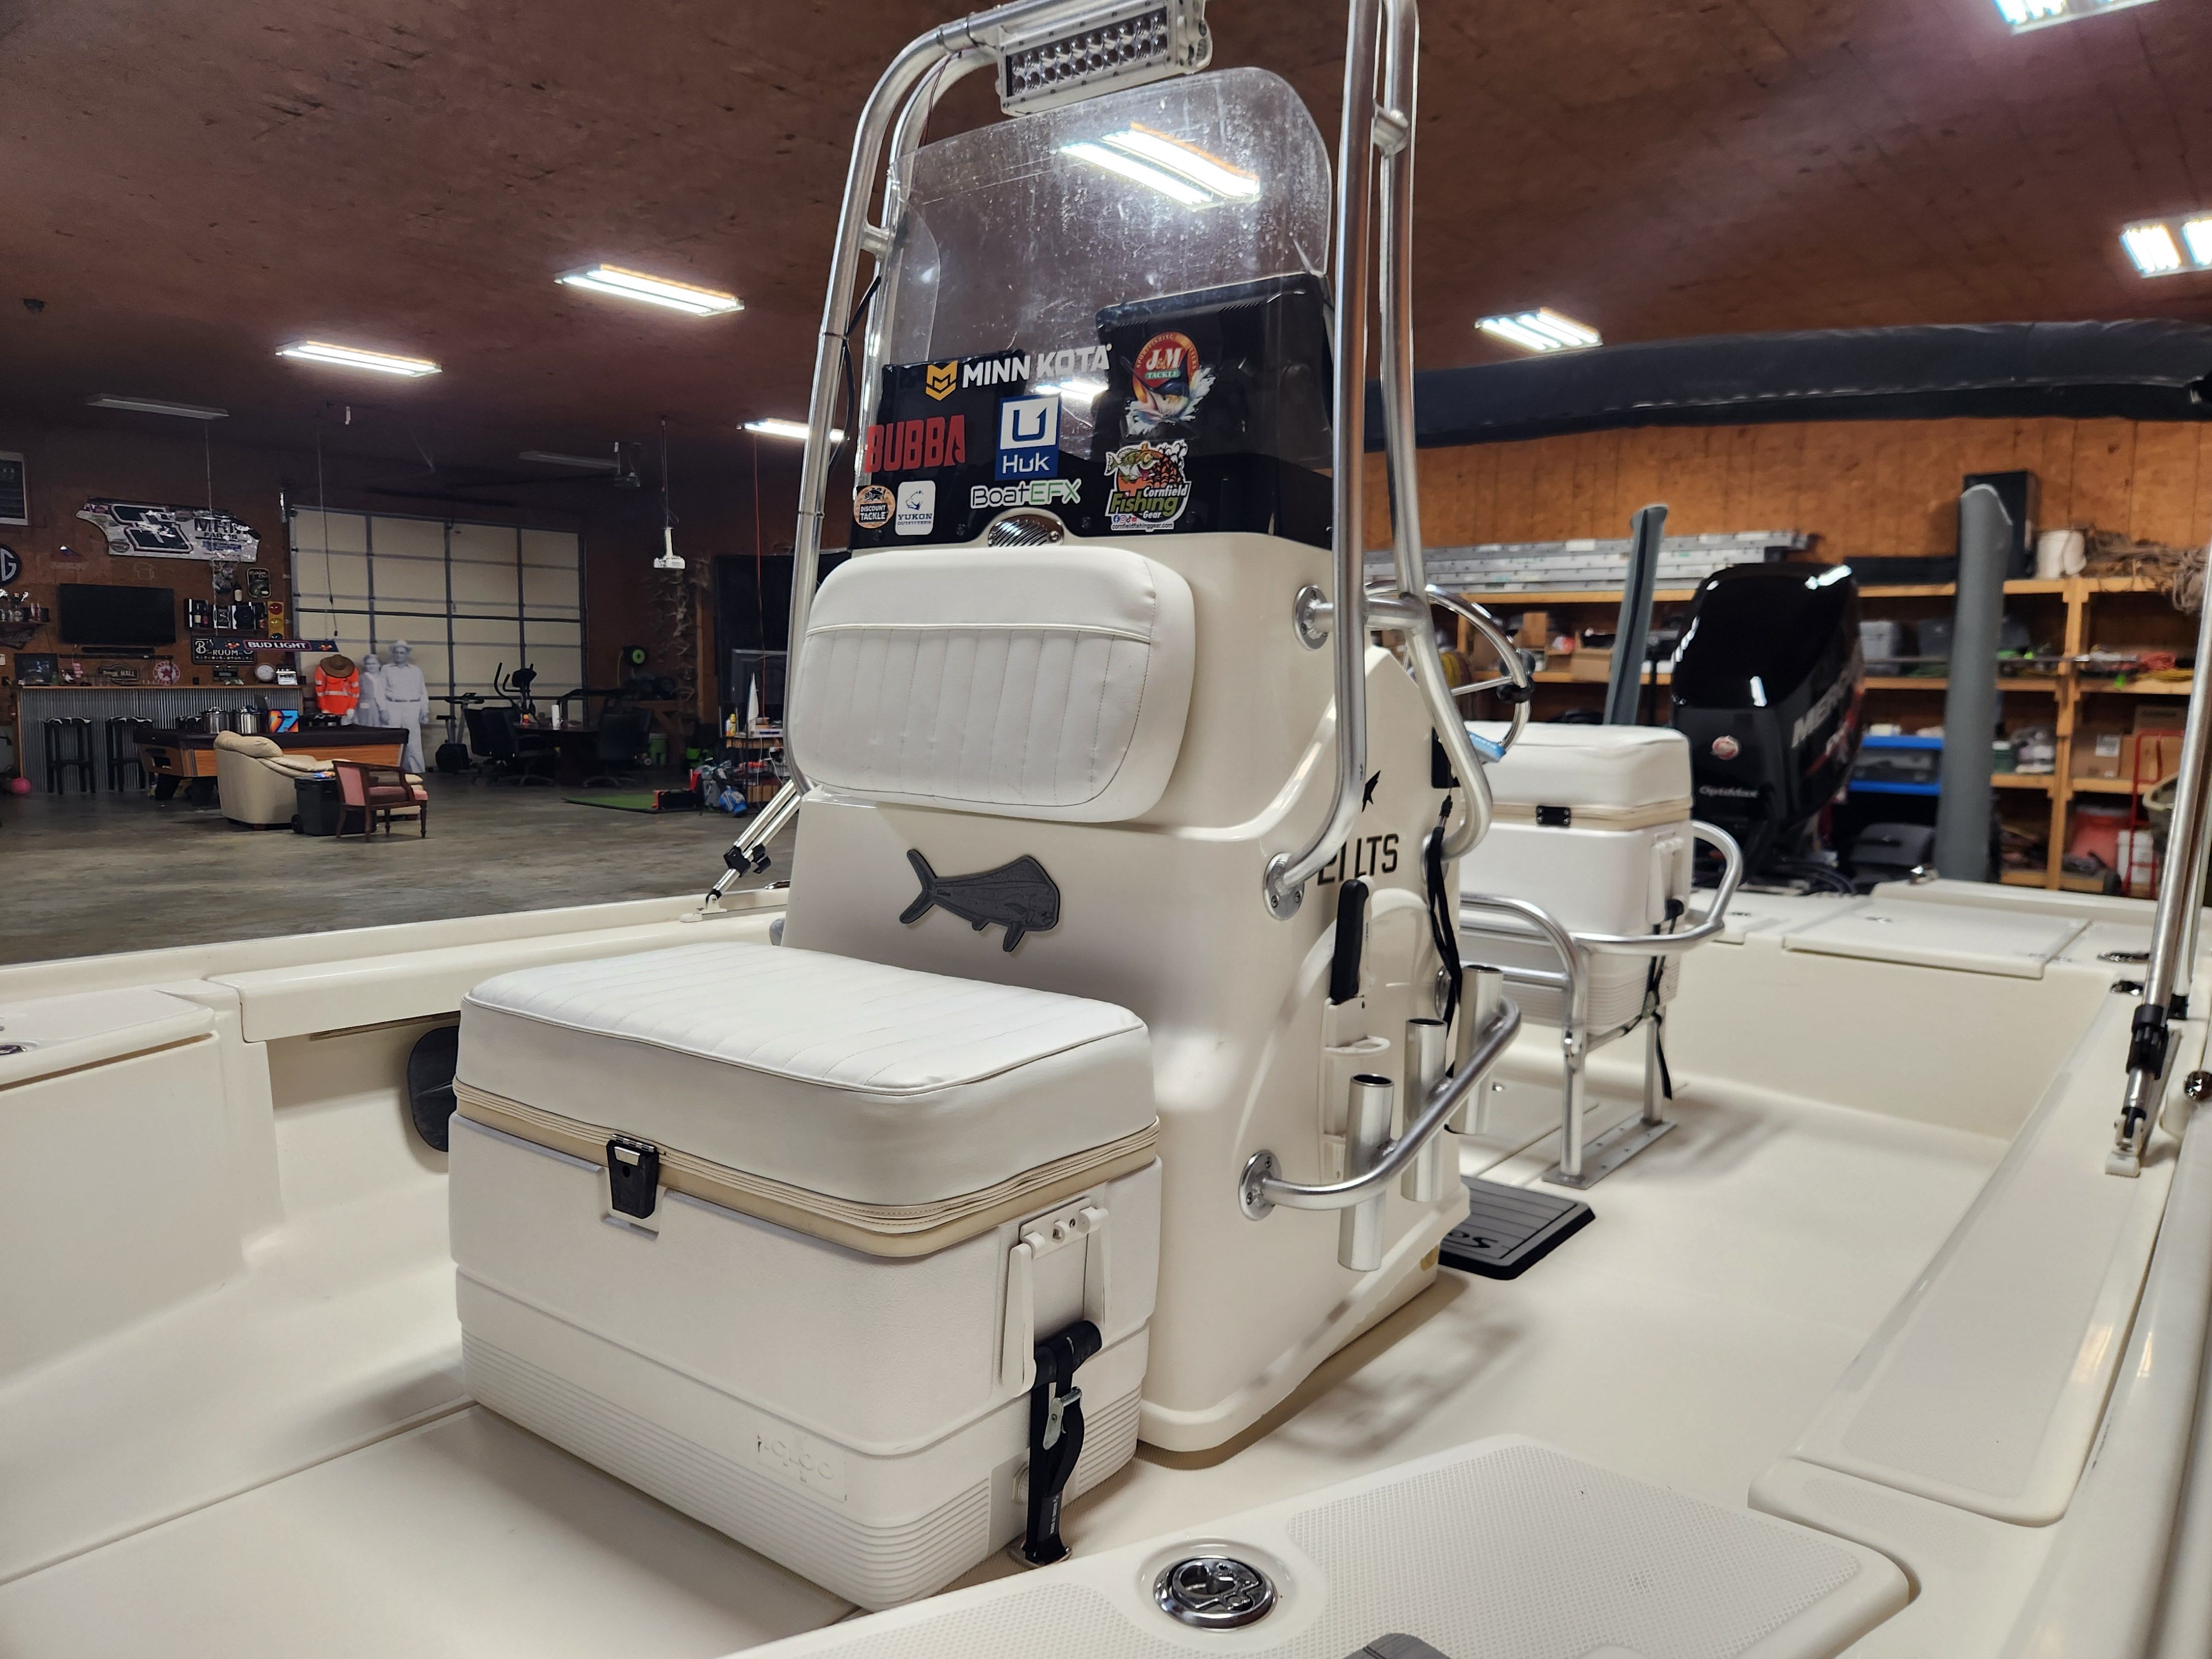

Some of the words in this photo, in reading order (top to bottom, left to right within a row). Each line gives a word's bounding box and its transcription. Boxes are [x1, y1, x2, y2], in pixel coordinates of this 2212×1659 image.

[962, 355, 1031, 388] MINN
[1036, 345, 1110, 378] KOTA
[1146, 347, 1183, 371] J&M
[1147, 371, 1179, 379] TACKLE
[864, 414, 966, 473] BUBBA
[972, 481, 1081, 507] BoatEFX
[1143, 483, 1189, 497] Cornfield
[1110, 491, 1178, 517] Fishing
[1142, 510, 1162, 519] Gear
[860, 512, 887, 521] TACKLE
